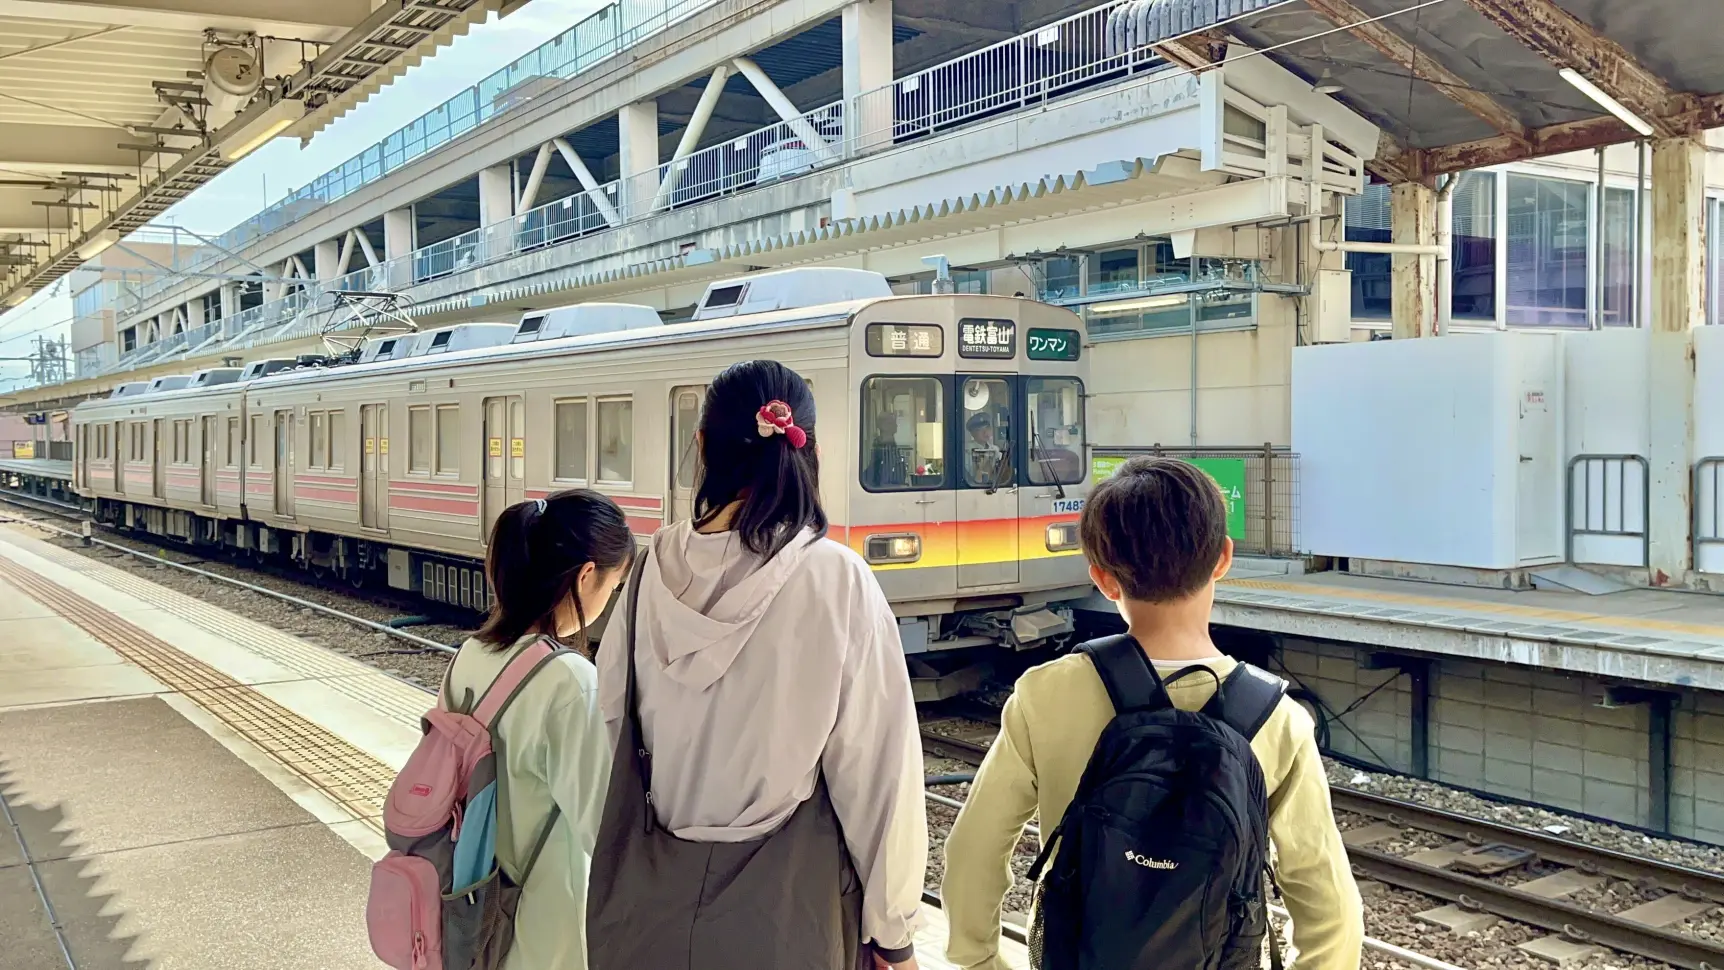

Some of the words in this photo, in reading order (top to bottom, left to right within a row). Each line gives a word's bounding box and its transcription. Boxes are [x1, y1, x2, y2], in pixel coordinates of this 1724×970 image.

[890, 329, 930, 350] 普通
[963, 324, 1010, 345] 電鉄富山
[962, 344, 1010, 353] DENTETSU-TOYAMA
[1029, 336, 1067, 352] ワンマン
[1135, 854, 1179, 870] Columbia
